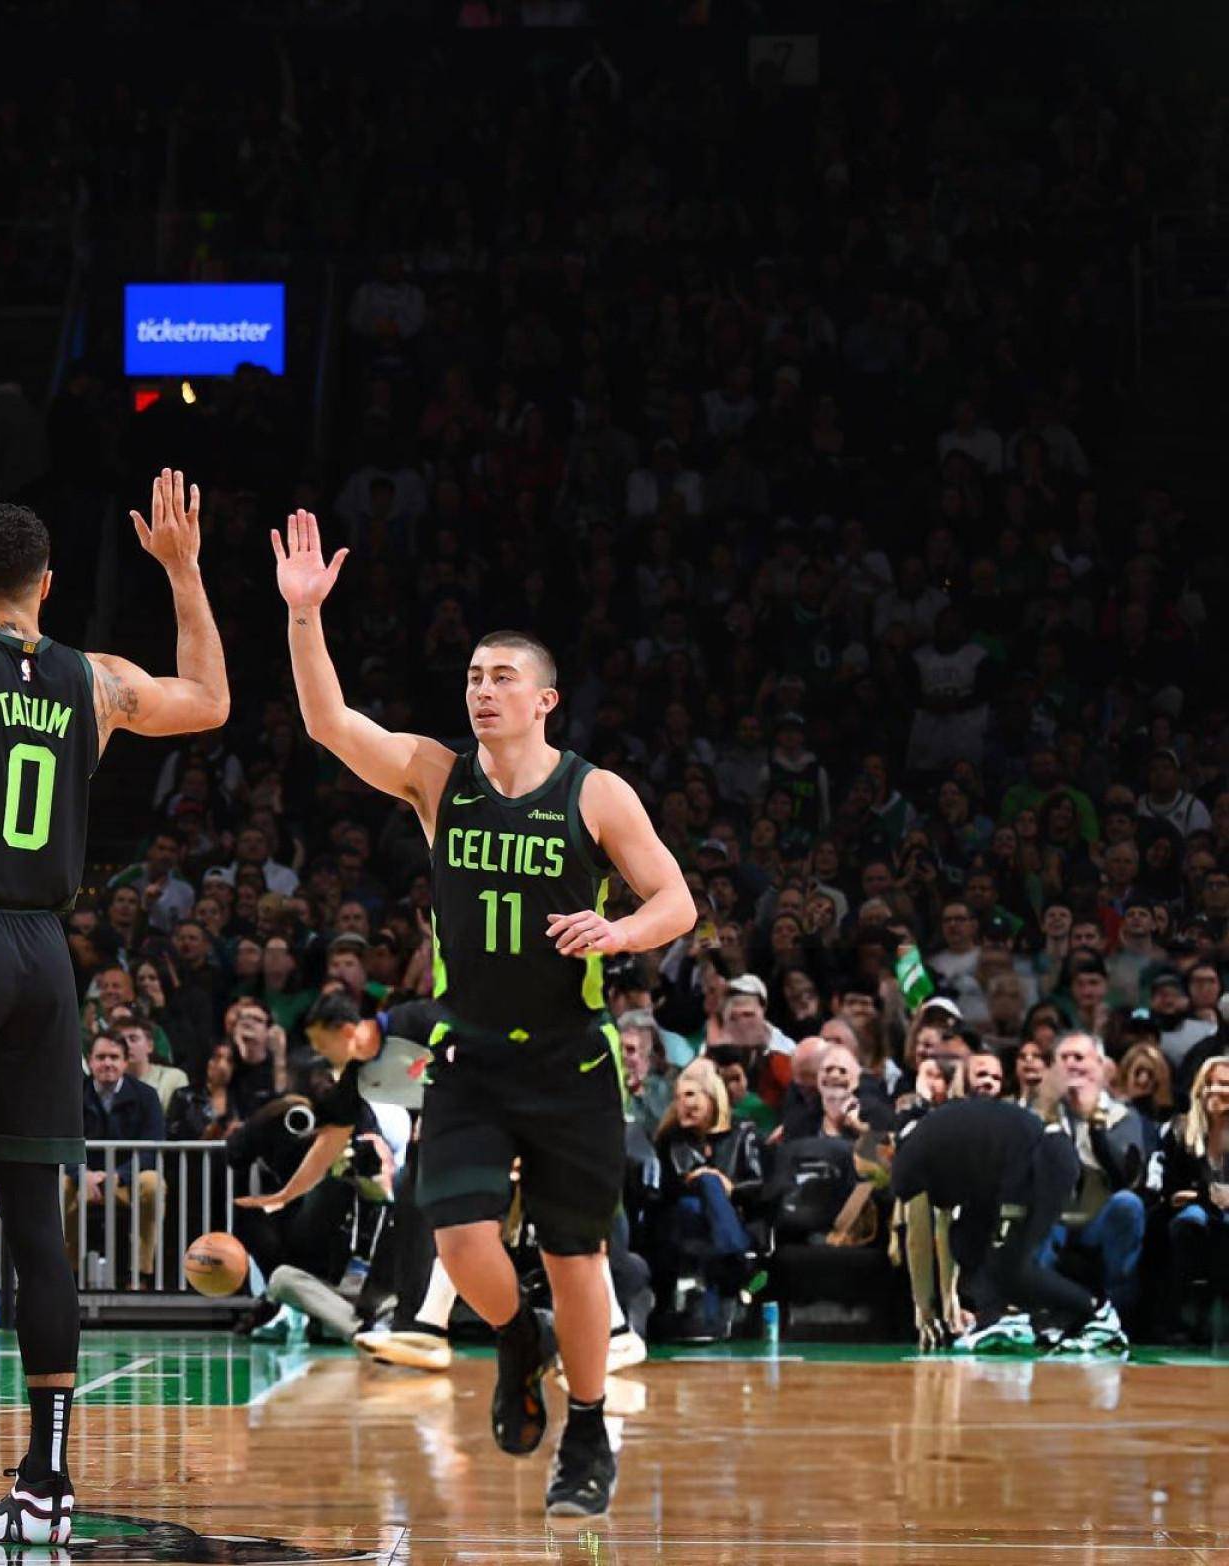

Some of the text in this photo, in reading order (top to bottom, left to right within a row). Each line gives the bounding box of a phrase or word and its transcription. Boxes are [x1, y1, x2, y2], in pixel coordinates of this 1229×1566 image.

[137, 317, 271, 343] ticketmaster
[2, 742, 57, 851] 0
[527, 808, 565, 822] Amica
[448, 827, 565, 878] CELTICS
[478, 890, 522, 954] 11
